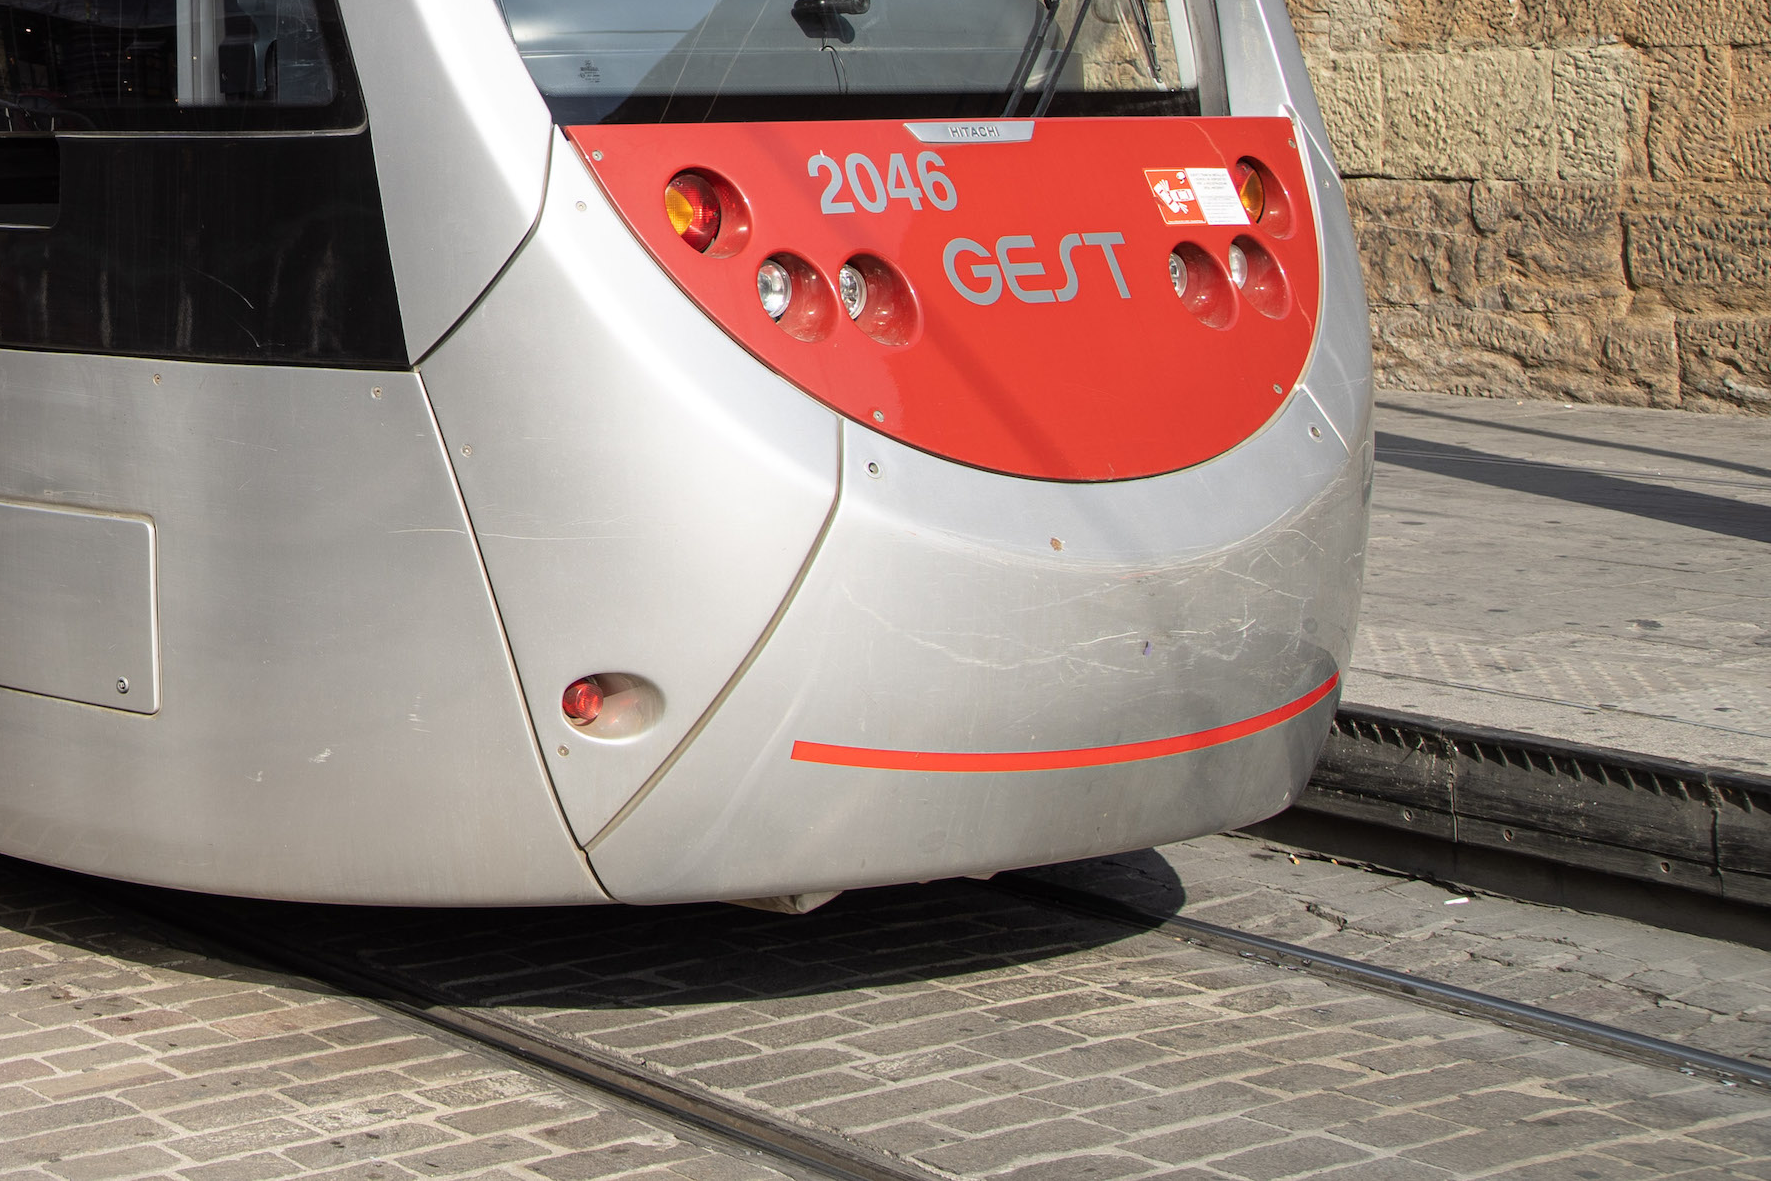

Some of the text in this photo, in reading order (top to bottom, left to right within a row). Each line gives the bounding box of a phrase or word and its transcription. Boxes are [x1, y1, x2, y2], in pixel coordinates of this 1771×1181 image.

[948, 126, 999, 138] HITACHI
[807, 150, 957, 215] 2046
[942, 232, 1131, 307] GEST
